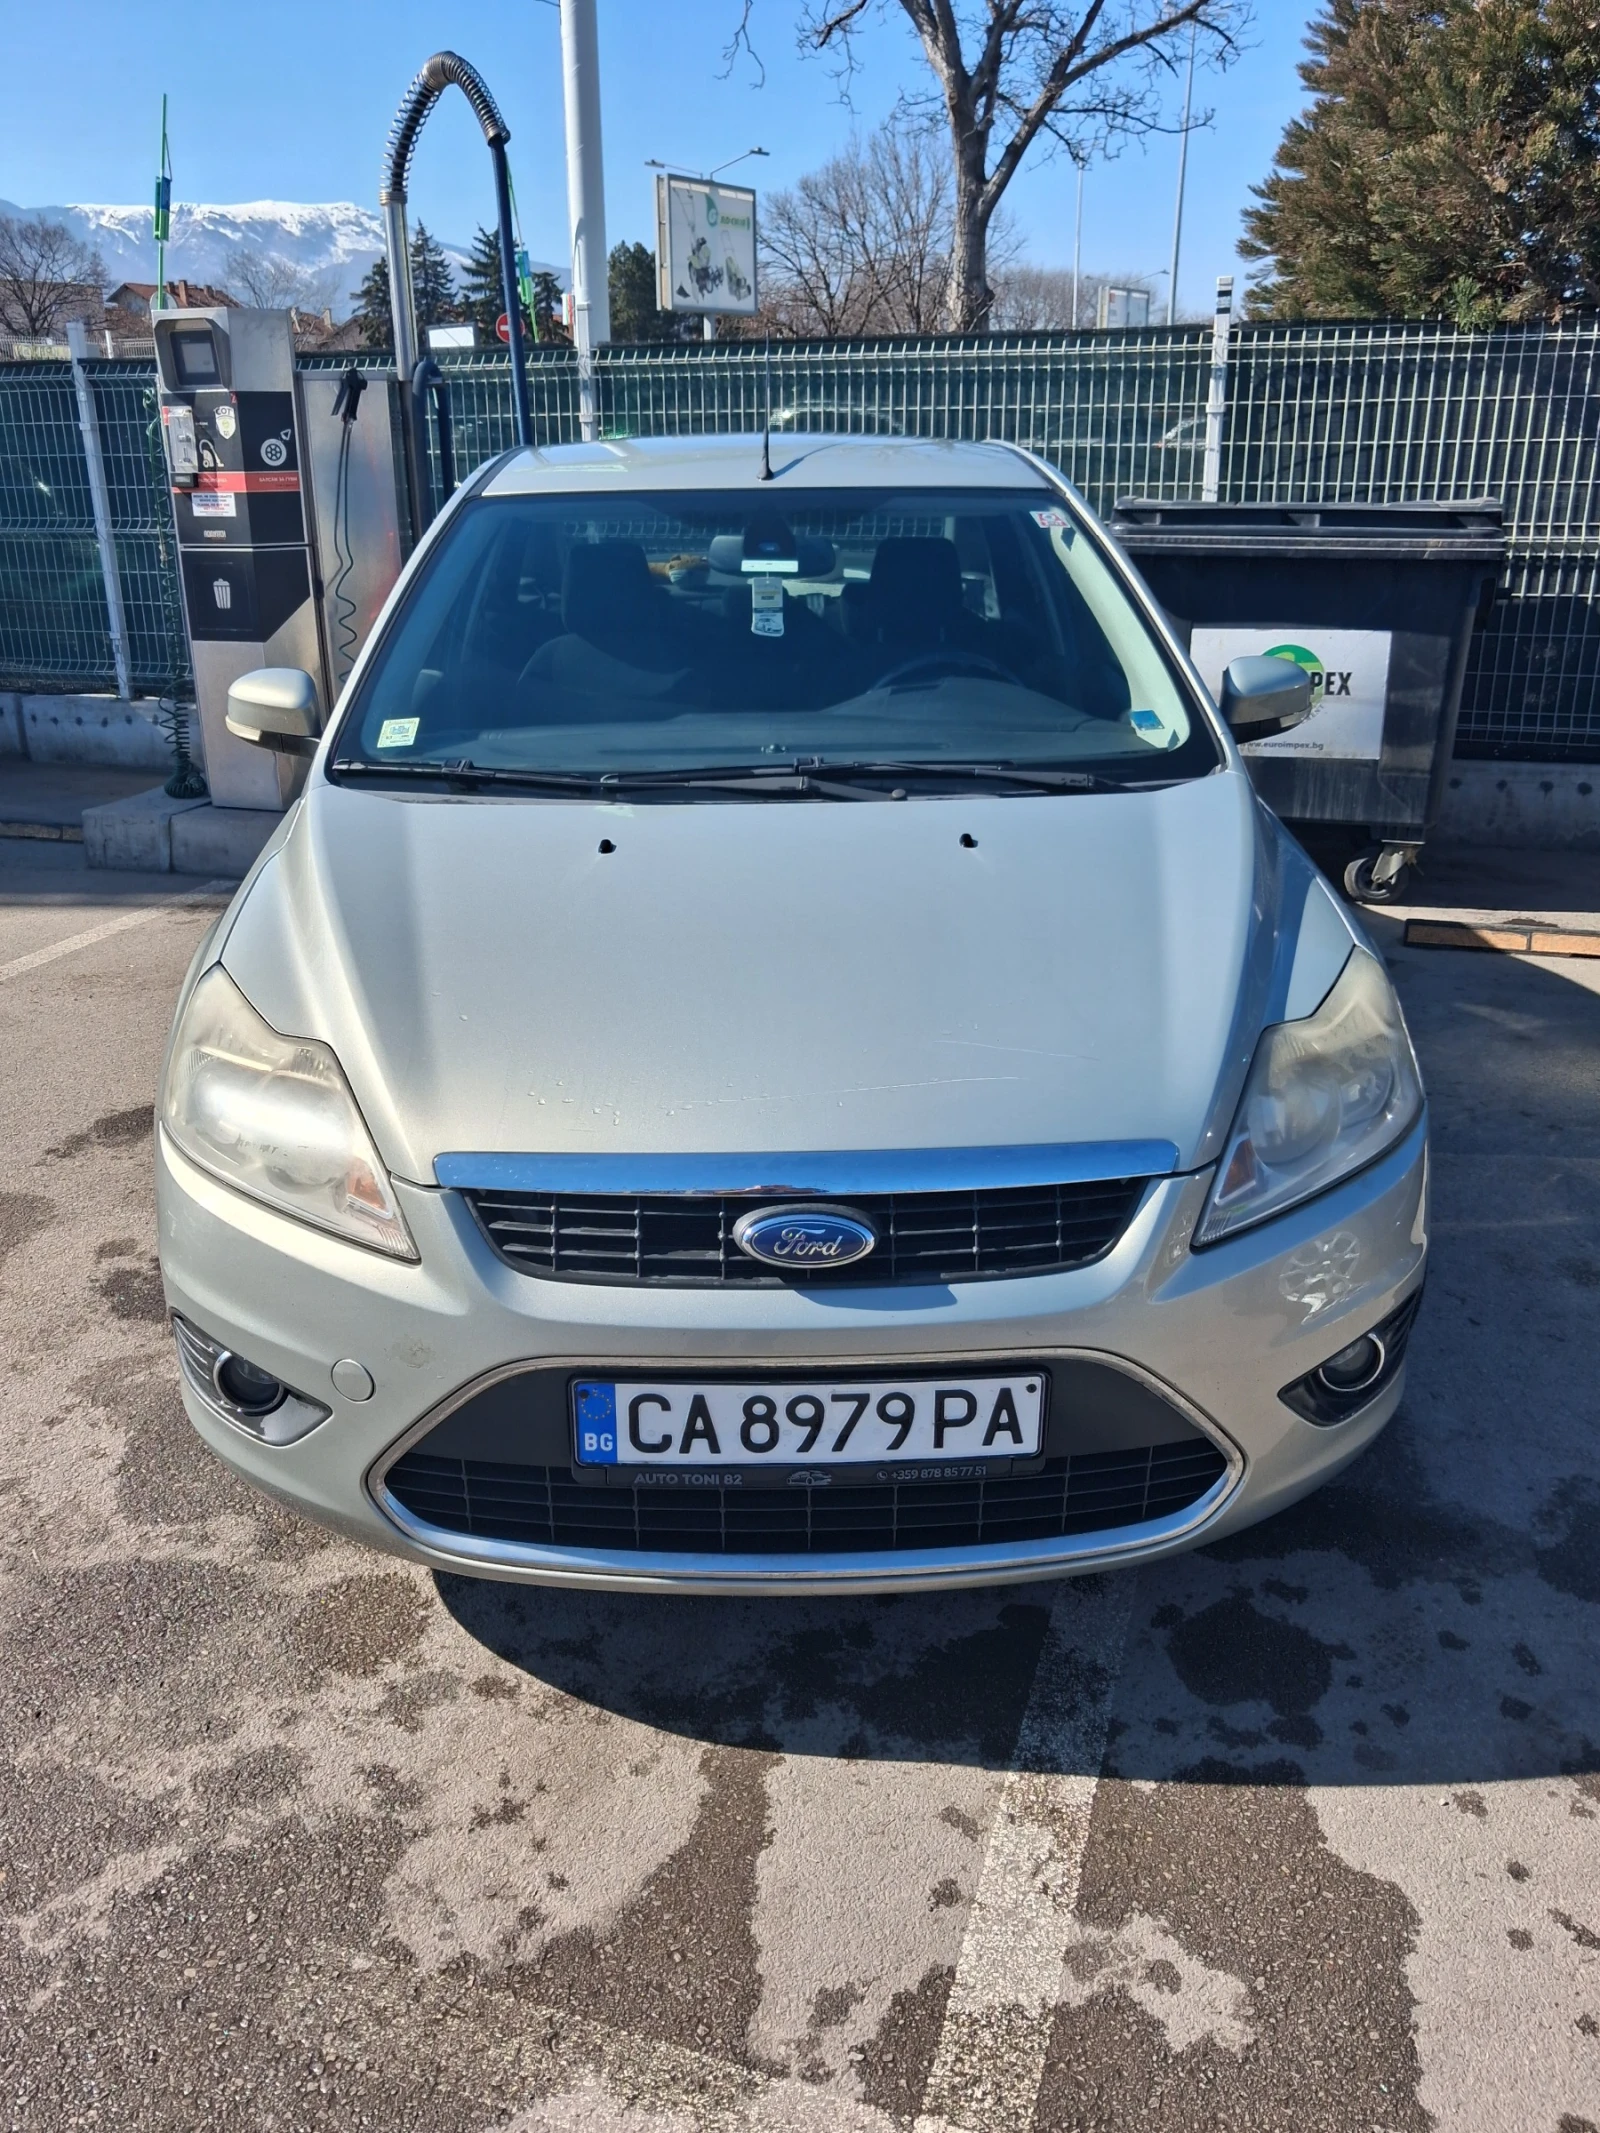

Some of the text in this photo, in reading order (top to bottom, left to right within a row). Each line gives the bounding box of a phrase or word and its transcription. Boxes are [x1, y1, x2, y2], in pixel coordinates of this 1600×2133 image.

[1310, 671, 1353, 696] PEX
[774, 1226, 843, 1256] Ford
[628, 1387, 1024, 1454] CA 8979 PA
[584, 1433, 613, 1451] BG
[634, 1473, 742, 1485] AUTO TONI 82
[891, 1465, 987, 1480] +359 878 85 77 51
